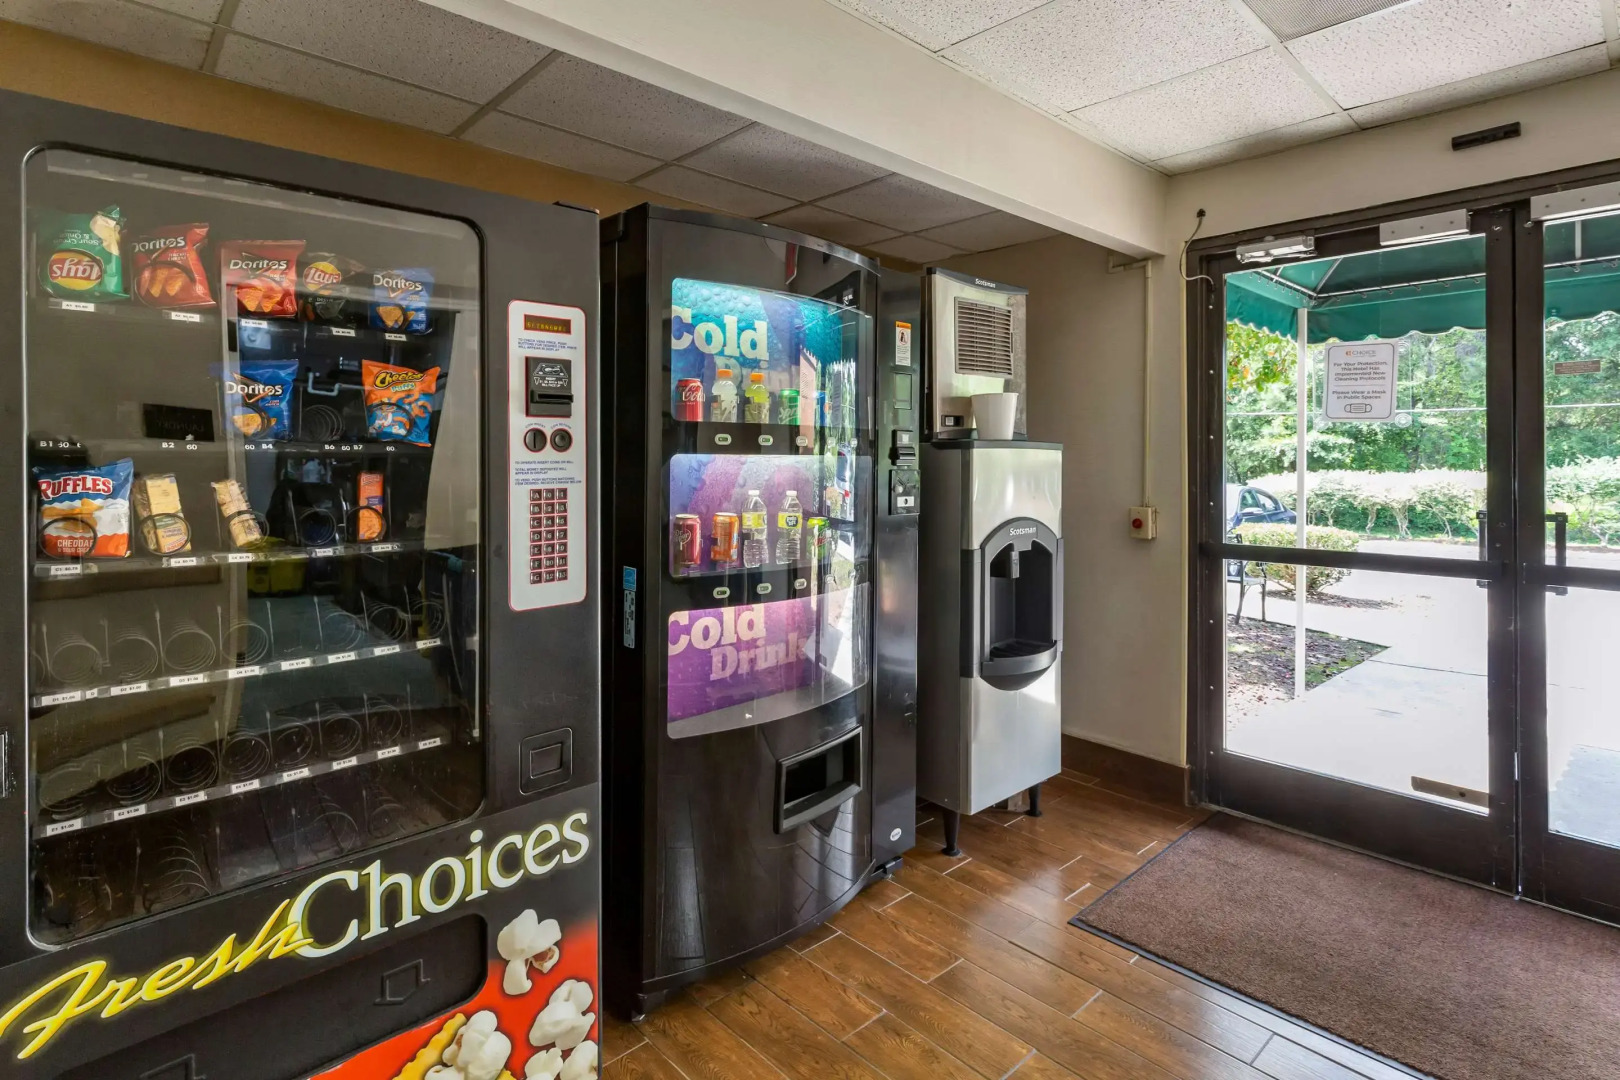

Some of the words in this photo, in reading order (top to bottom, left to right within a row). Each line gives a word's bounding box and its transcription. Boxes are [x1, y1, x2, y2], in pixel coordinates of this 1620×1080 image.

[229, 258, 288, 270] Doritos
[373, 274, 422, 291] Doritos
[975, 278, 996, 289] Scotsman
[671, 305, 769, 361] Cold
[375, 371, 425, 388] Cheetos
[224, 381, 284, 396] Doritos
[38, 475, 114, 501] RUFFLES
[1009, 526, 1036, 536] Scotsman
[668, 604, 767, 656] Cold
[126, 807, 140, 815] $1.00
[60, 823, 75, 831] $1.00
[0, 898, 314, 1059] Fresh
[288, 811, 591, 959] Choices
